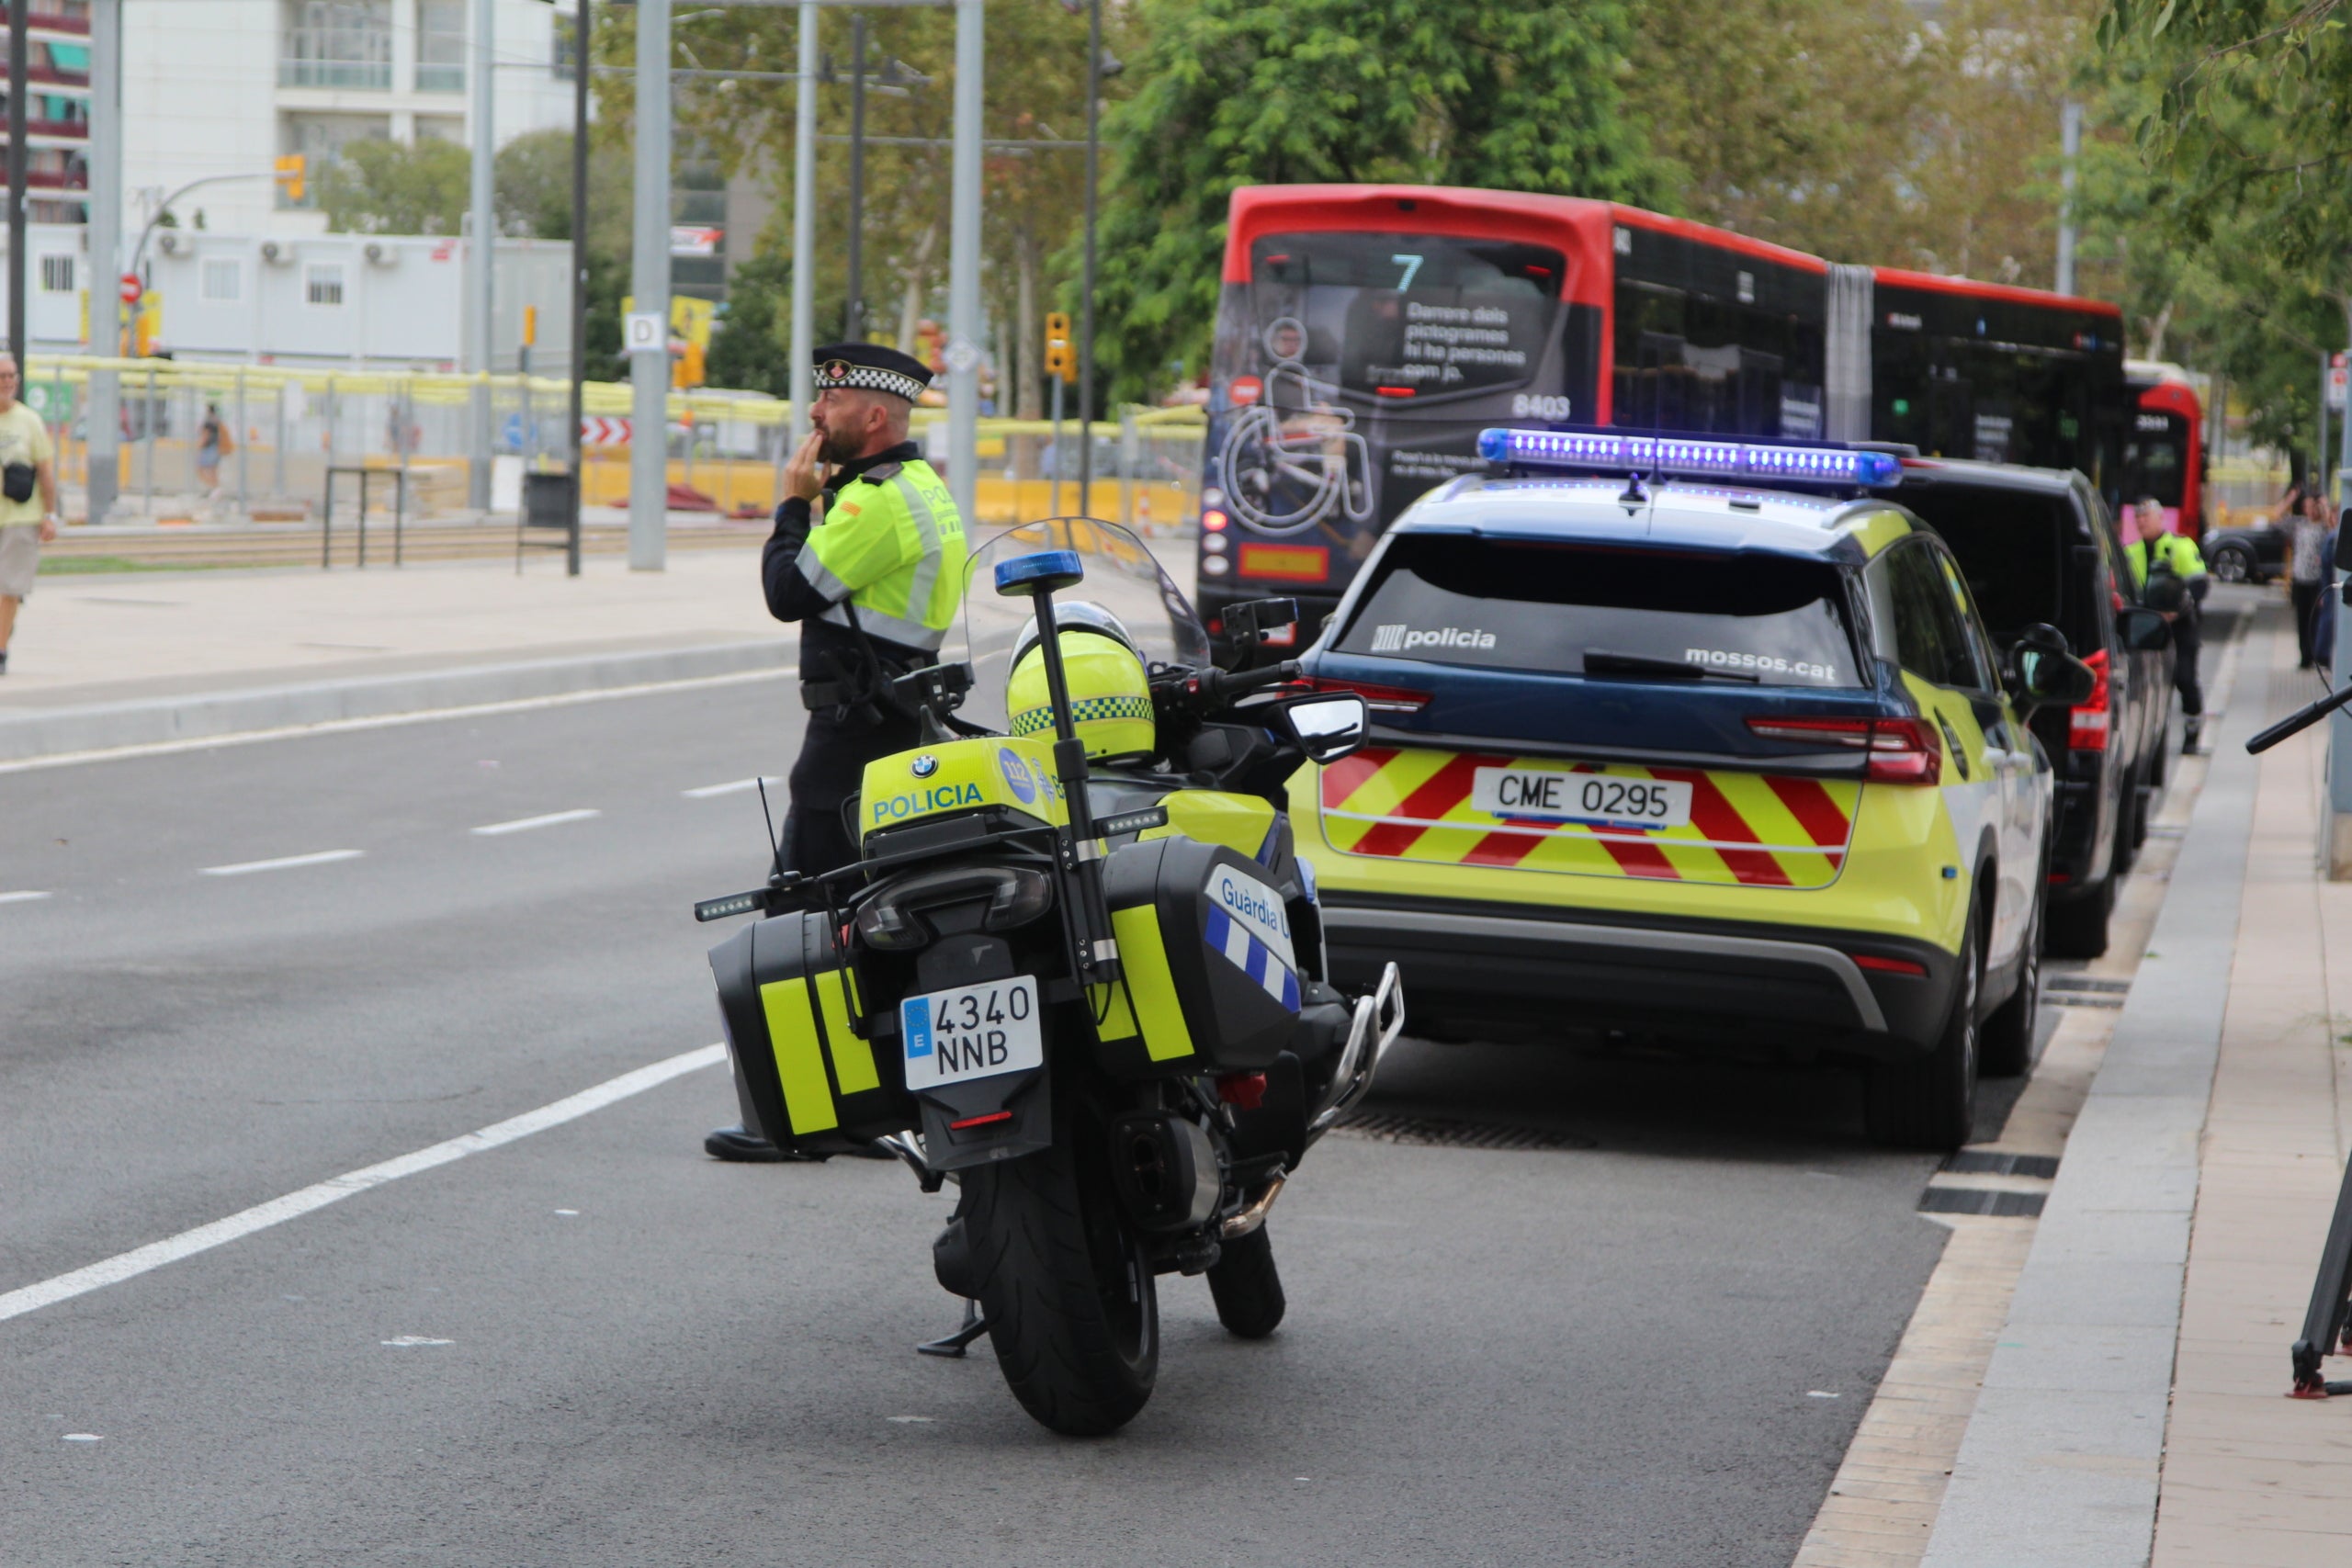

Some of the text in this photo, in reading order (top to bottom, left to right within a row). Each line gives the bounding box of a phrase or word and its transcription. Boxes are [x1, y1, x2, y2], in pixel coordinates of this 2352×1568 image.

[1391, 254, 1424, 293] 7
[1407, 301, 1509, 324] Darrere dels
[634, 319, 654, 342] D
[1404, 322, 1510, 345] pictogrames
[1403, 341, 1527, 367] hi ha persones
[1512, 393, 1571, 421] 8403
[1403, 627, 1497, 650] policia
[1685, 648, 1836, 680] mossos.cat
[1004, 761, 1030, 782] 112
[873, 783, 984, 824] POLICIA
[1498, 774, 1668, 818] CME 0295
[1222, 877, 1278, 931] Guàrdia
[936, 986, 1030, 1034] 4340
[913, 1033, 924, 1047] E
[937, 1030, 1009, 1075] NNB
